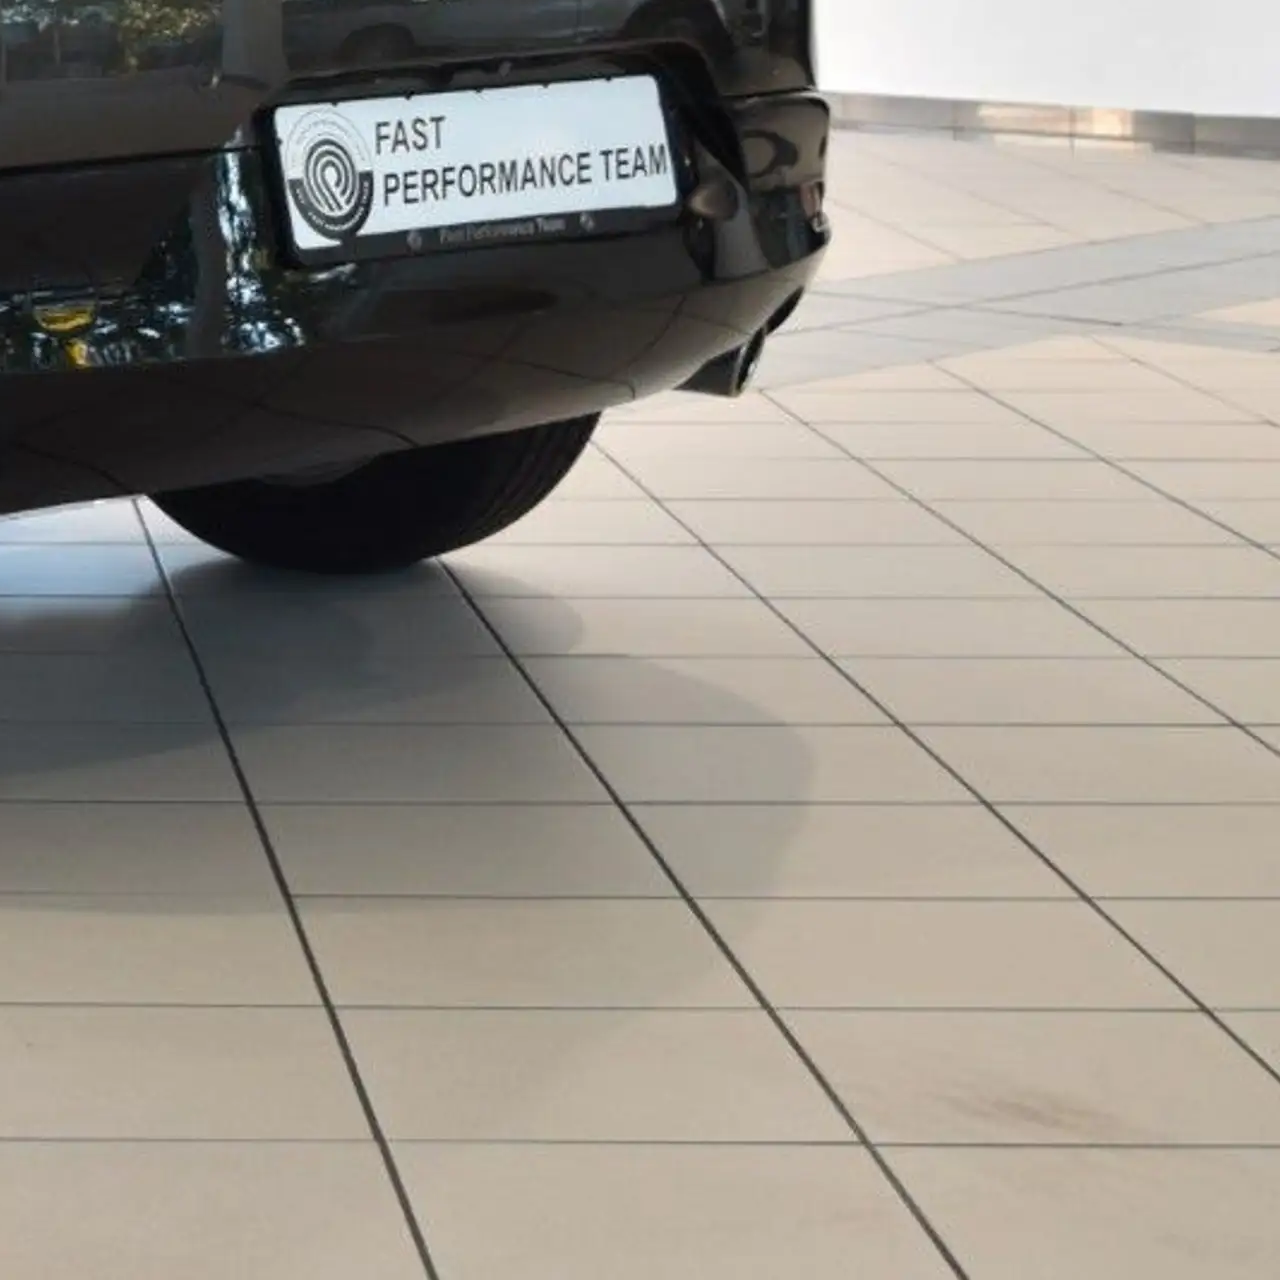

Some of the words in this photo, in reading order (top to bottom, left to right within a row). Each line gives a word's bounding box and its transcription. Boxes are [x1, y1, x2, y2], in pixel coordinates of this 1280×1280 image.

[375, 116, 446, 155] FAST
[384, 152, 592, 206] PERFORMANCE
[599, 143, 667, 181] TEAM
